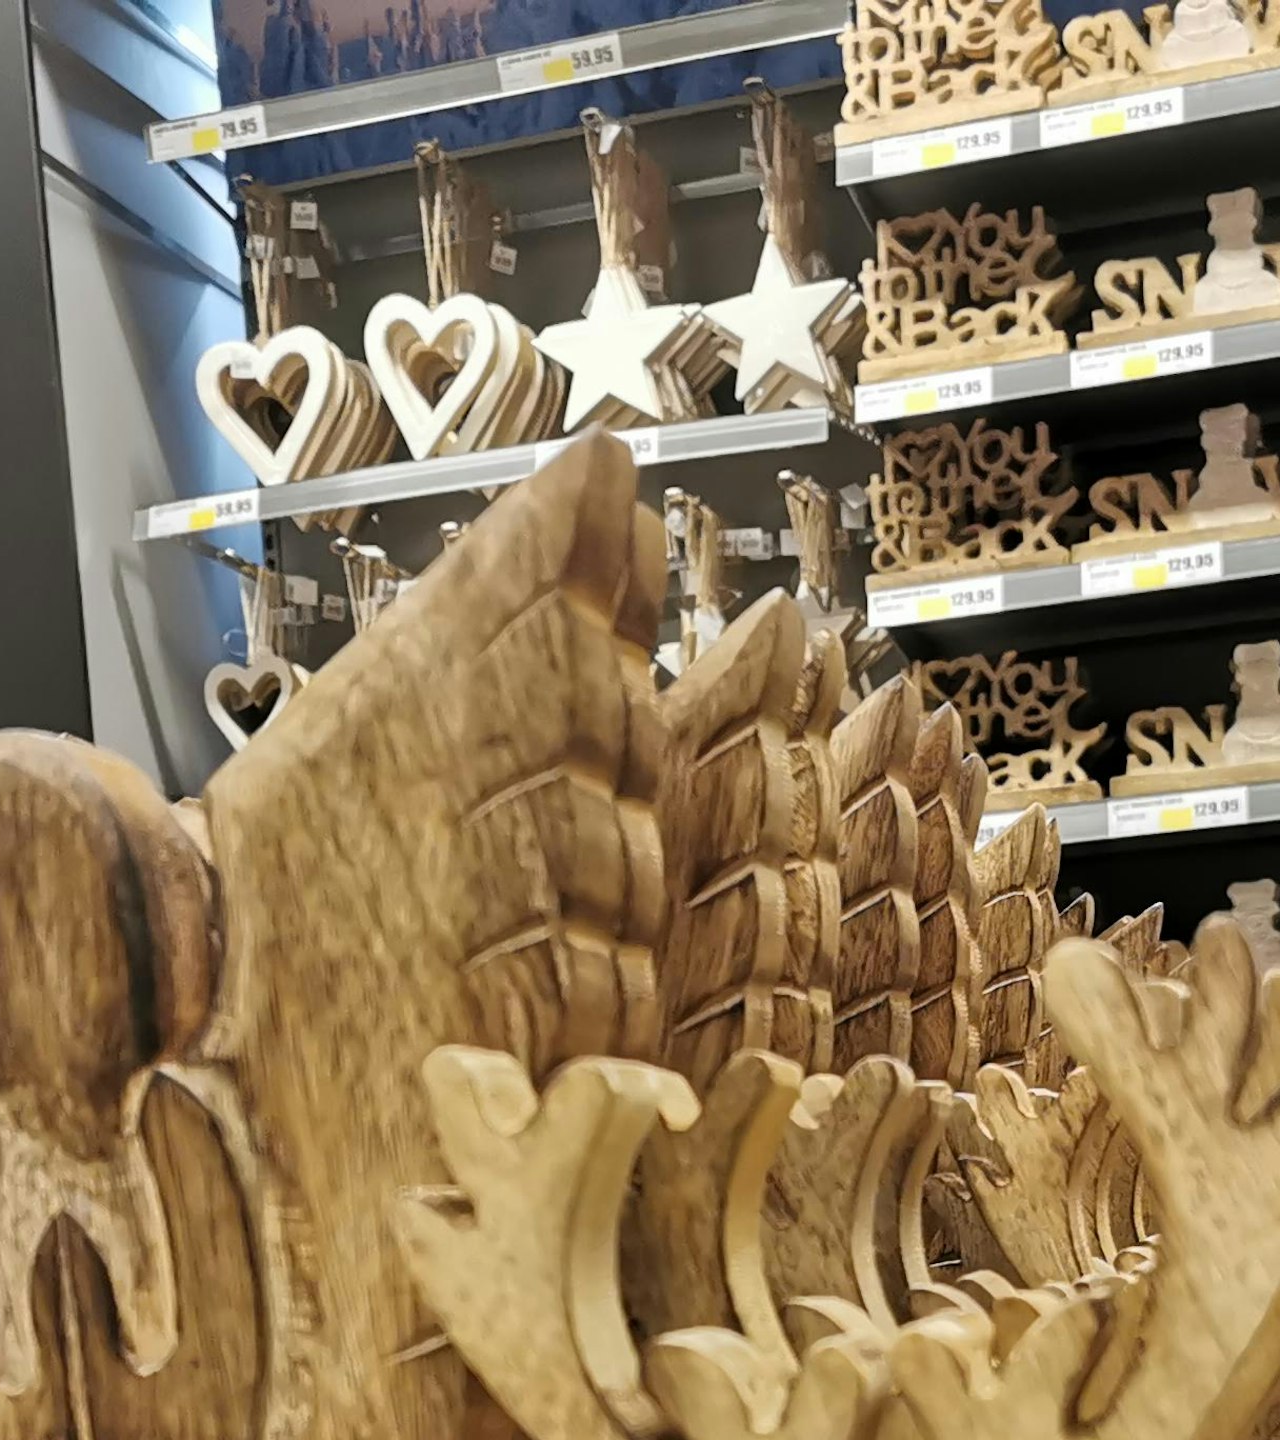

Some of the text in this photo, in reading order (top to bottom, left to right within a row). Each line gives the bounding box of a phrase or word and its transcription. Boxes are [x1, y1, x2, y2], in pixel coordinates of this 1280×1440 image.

[572, 45, 615, 71] 59.95
[1125, 100, 1173, 120] 129.95
[221, 117, 258, 139] 79.95
[956, 131, 1002, 149] 129.95
[1156, 342, 1204, 362] 129.95
[937, 381, 983, 400] 129.95
[1167, 552, 1214, 572] 129.95
[950, 587, 995, 606] 129.95
[1193, 798, 1240, 818] 129.95
